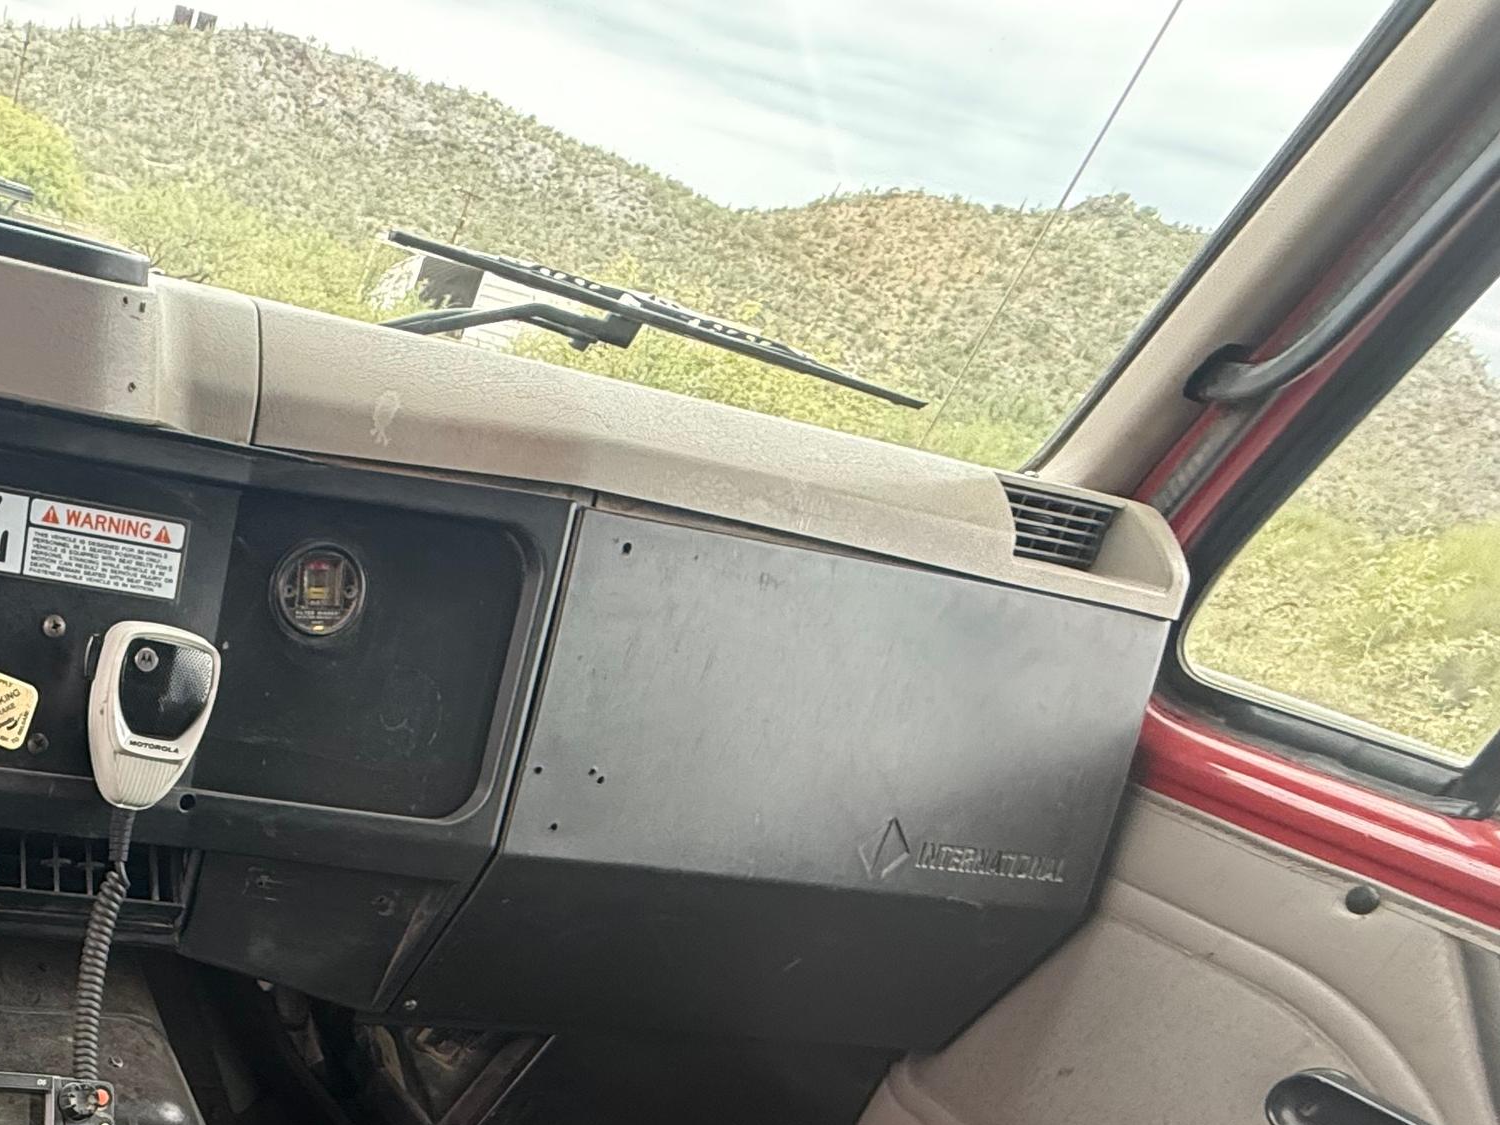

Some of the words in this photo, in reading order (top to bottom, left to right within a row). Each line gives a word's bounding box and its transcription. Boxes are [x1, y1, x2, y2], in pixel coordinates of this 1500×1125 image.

[66, 509, 151, 539] WARNING
[129, 740, 180, 754] MOTOROLA
[915, 841, 1065, 883] INTERNATIONAL
